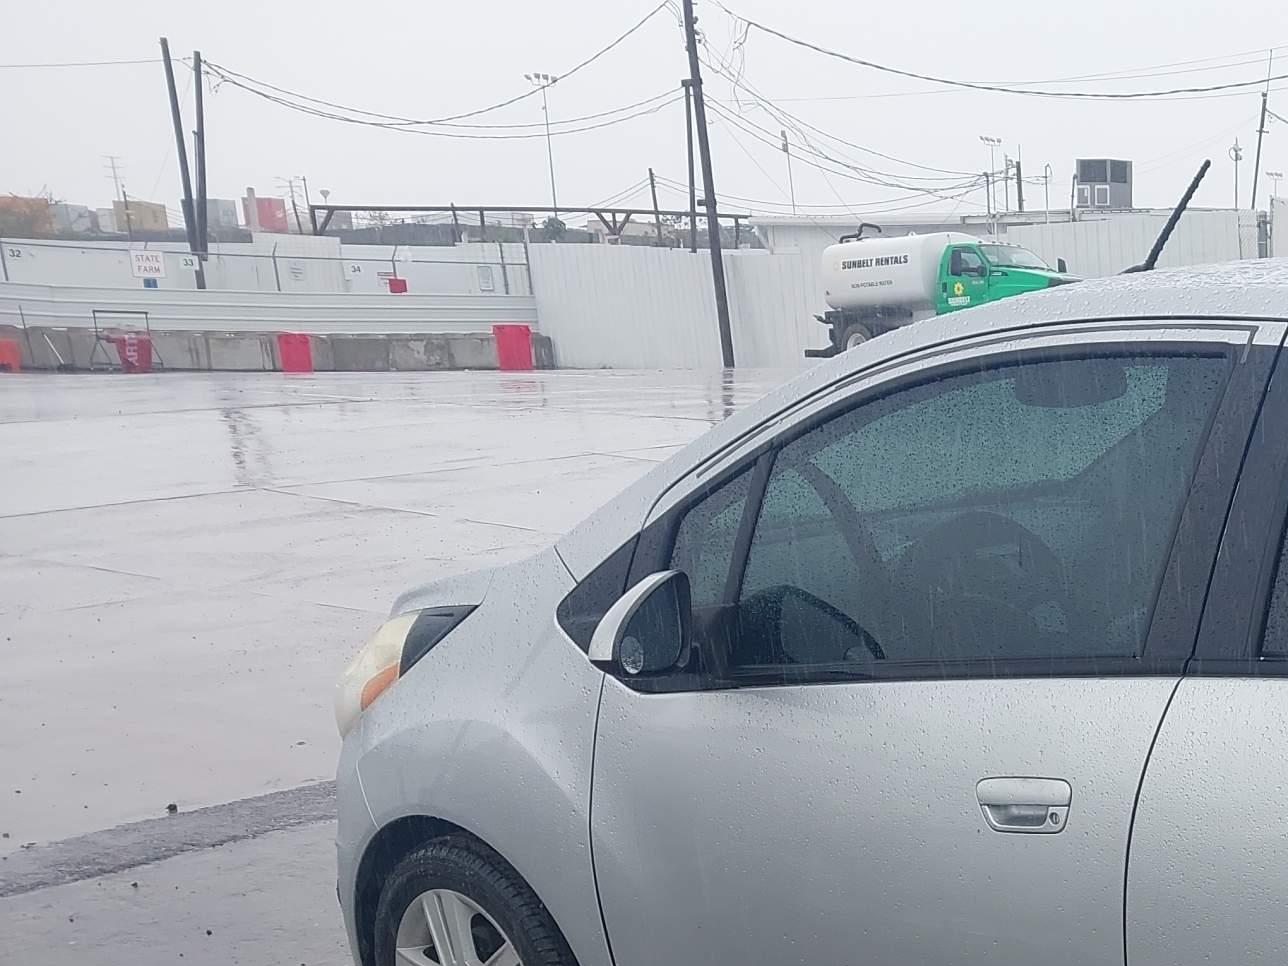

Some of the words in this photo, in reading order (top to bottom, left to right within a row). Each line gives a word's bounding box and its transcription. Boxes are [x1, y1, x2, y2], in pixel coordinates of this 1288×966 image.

[9, 249, 21, 257] 32
[135, 254, 160, 263] STATE
[841, 259, 874, 270] SUNBELT
[875, 254, 909, 267] RENTALS
[137, 265, 160, 273] FARM
